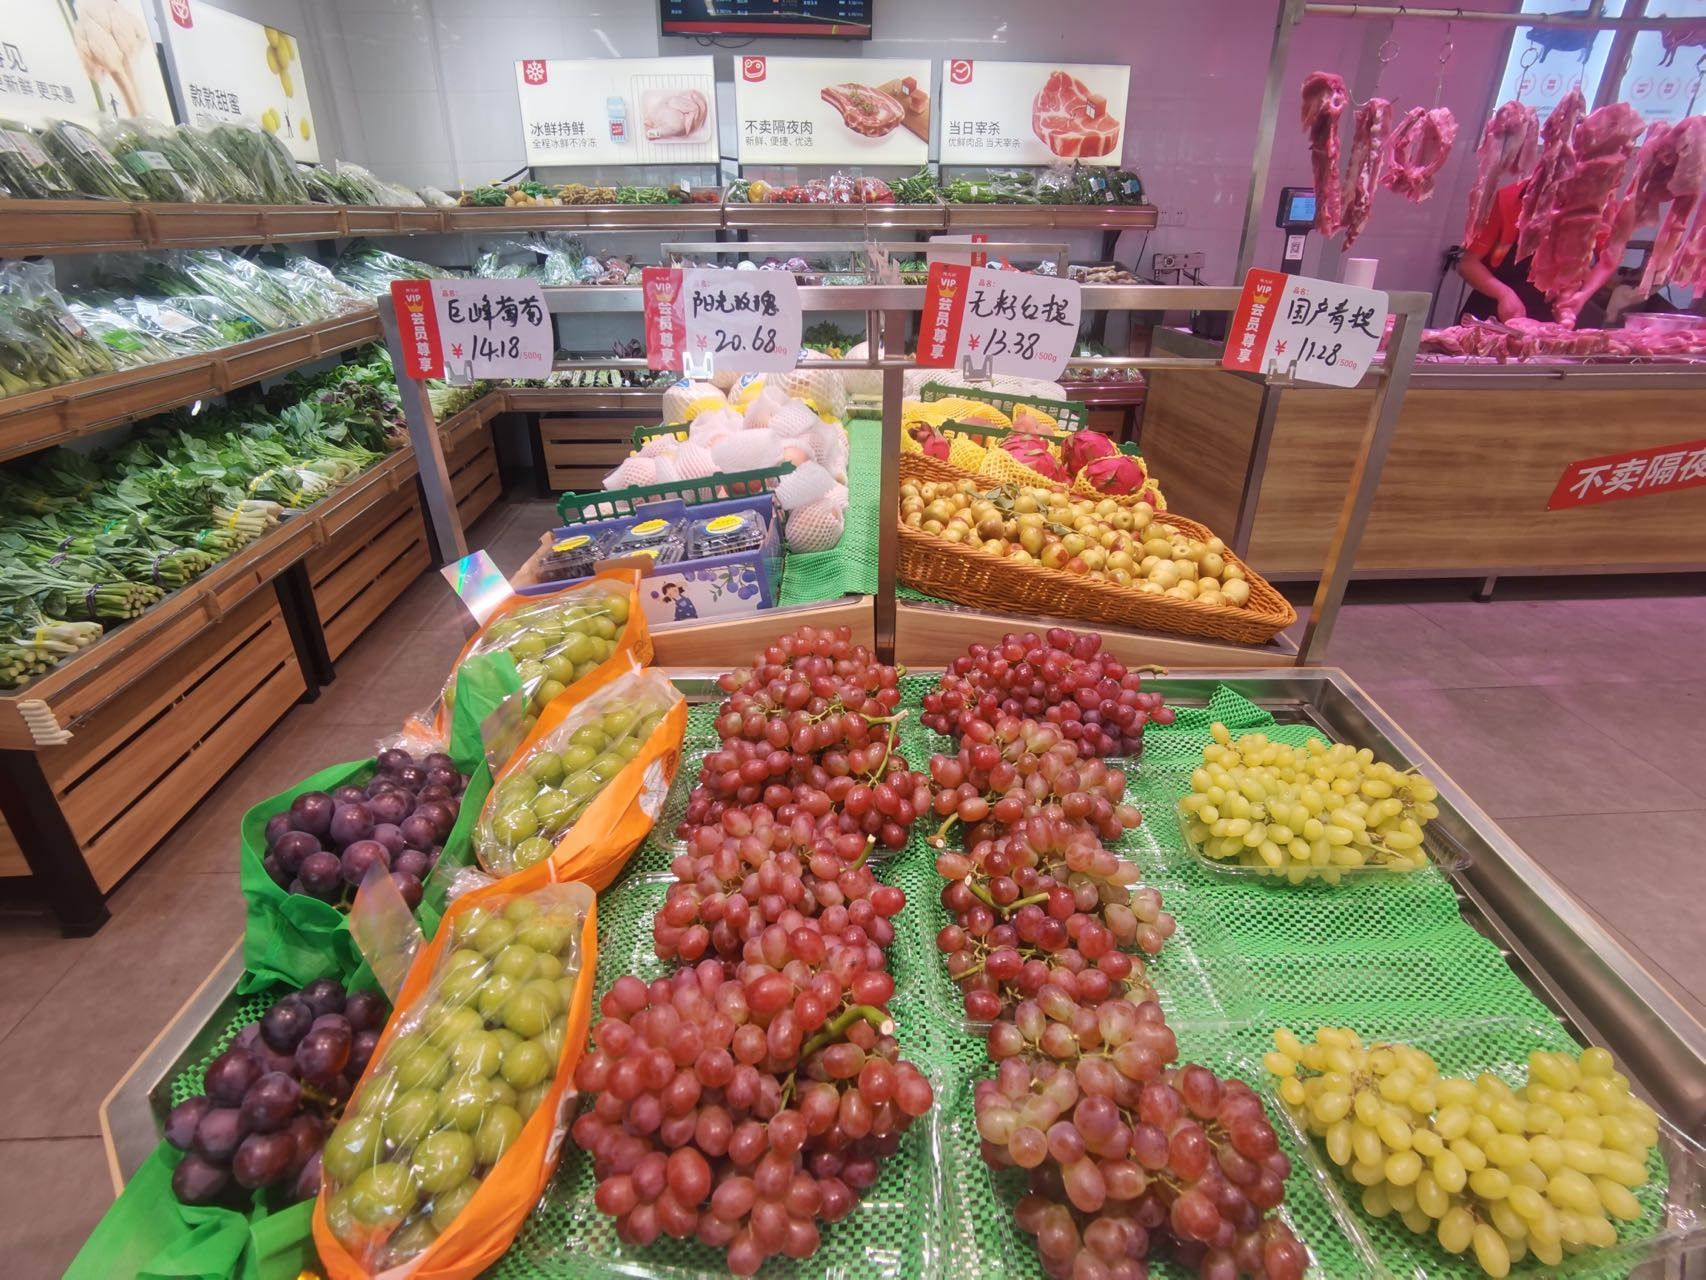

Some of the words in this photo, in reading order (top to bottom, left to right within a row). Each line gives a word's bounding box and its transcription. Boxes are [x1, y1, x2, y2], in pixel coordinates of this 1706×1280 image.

[0, 41, 29, 73] 见
[530, 121, 586, 137] 冰鲜持鲜
[744, 119, 813, 135] 不卖隔夜肉
[949, 120, 1001, 136] 当日宰杀
[532, 138, 598, 149] 全程冰鲜不冷冻
[986, 138, 1021, 148] 当天宰杀
[655, 283, 672, 292] VIP
[940, 277, 957, 288] VIP
[1256, 284, 1273, 294] VIP
[405, 294, 421, 303] VIP
[448, 294, 543, 331] 巨峰葡萄
[692, 290, 780, 318] 阳光玫瑰
[968, 289, 1075, 327] 无籽红提
[929, 297, 953, 360] 会员尊享
[1287, 297, 1380, 339] 国产青提
[410, 313, 433, 372] 会员尊享
[657, 302, 675, 364] 会员尊享
[714, 325, 777, 354] 20.68
[983, 328, 1041, 361] 13.38
[1236, 303, 1265, 363] 会员尊享
[471, 335, 520, 362] 14.18
[1296, 337, 1343, 367] 11.28
